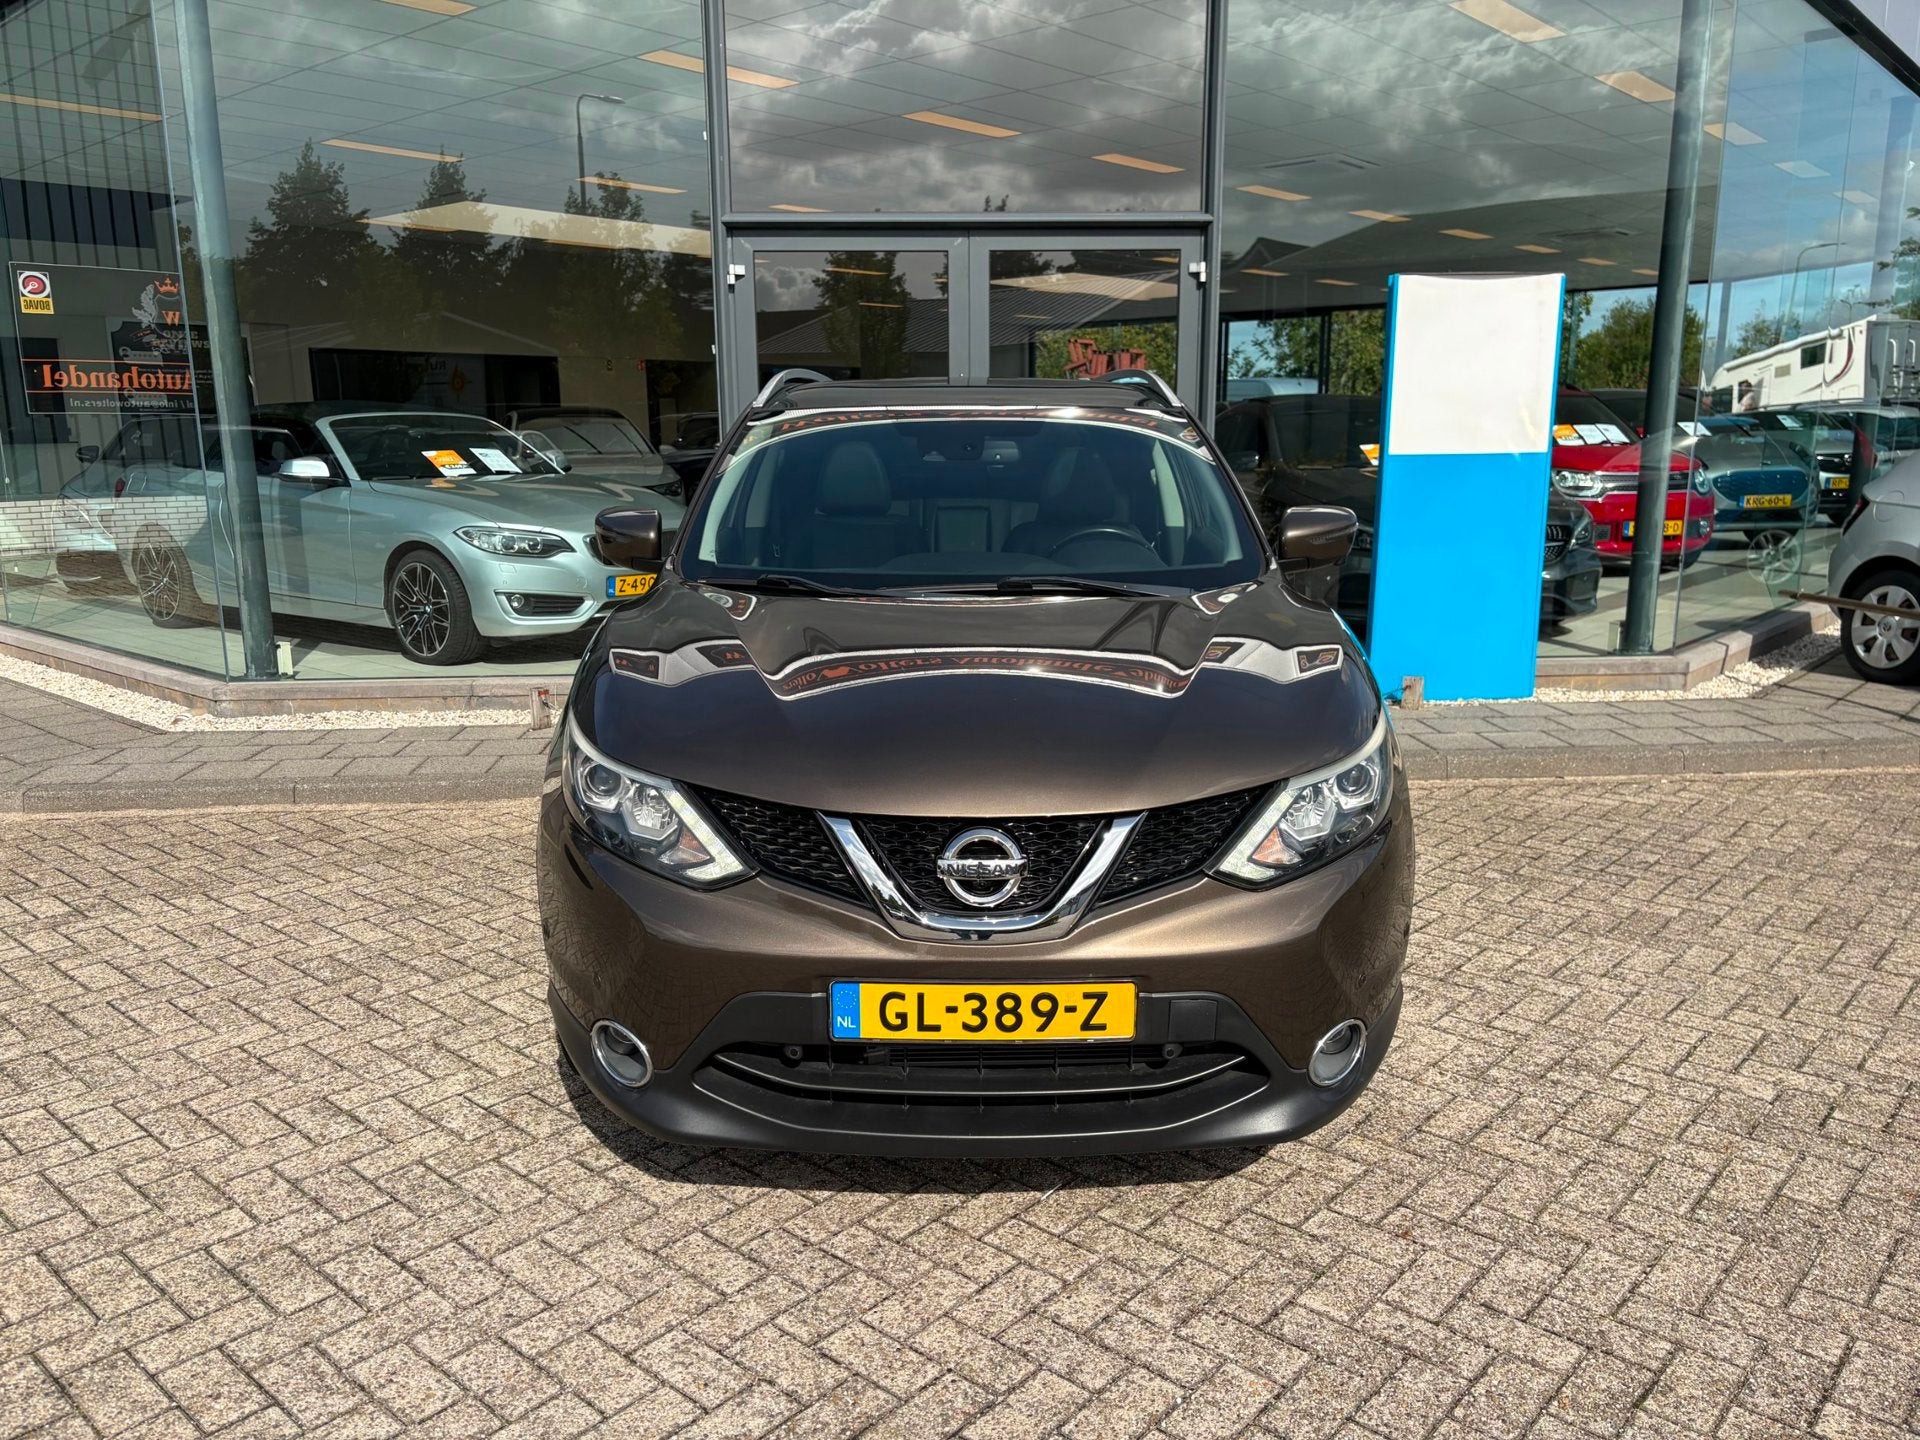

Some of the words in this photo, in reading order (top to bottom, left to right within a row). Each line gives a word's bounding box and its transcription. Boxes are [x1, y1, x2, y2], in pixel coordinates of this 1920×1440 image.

[945, 863, 1019, 877] NISSAN
[836, 1015, 856, 1028] NL
[879, 991, 1109, 1033] GL-389-Z
